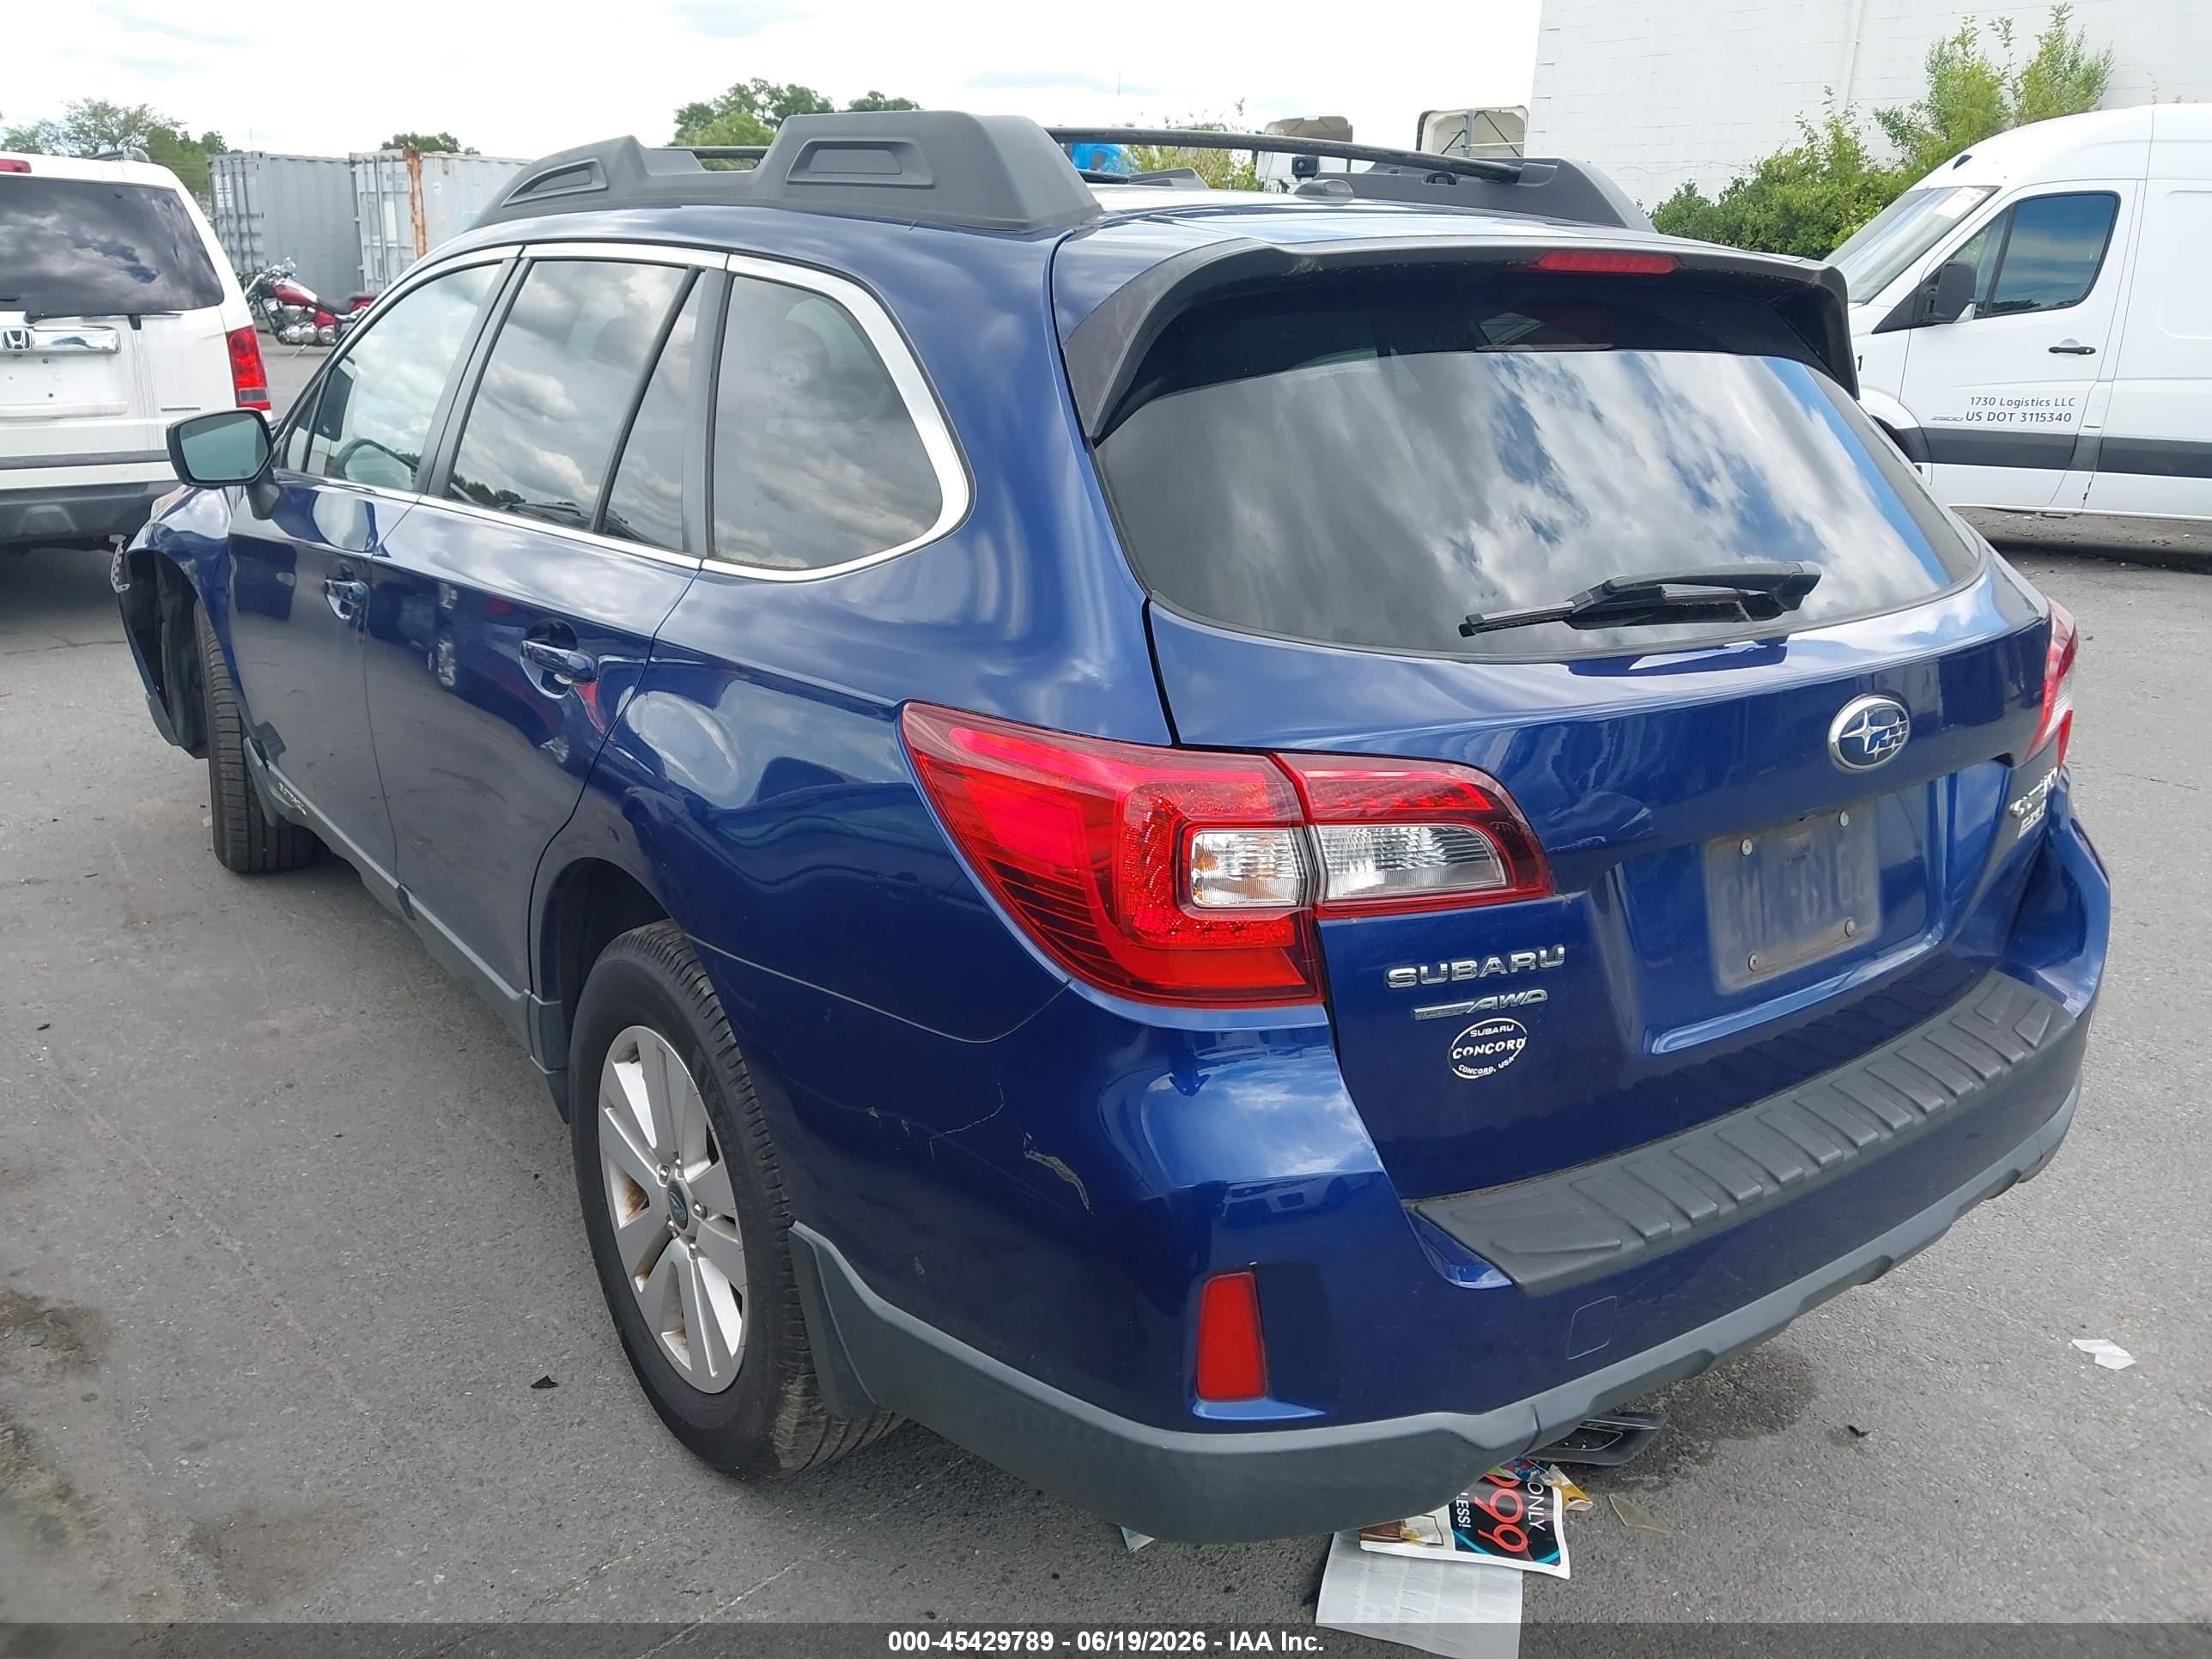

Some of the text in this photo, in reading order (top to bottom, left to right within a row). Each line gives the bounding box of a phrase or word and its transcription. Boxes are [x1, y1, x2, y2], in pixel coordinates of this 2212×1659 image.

[1970, 397, 2075, 409] 1730 Logistics LLC
[1966, 411, 2072, 422] US DOT 3115340
[1387, 945, 1565, 988] SUBARU
[1466, 989, 1548, 1014] AWD
[1469, 1024, 1515, 1038] SUBARU
[1452, 1038, 1526, 1060] CONCORD
[1458, 1064, 1497, 1076] CONCORD,
[1527, 1482, 1547, 1532] ONLY
